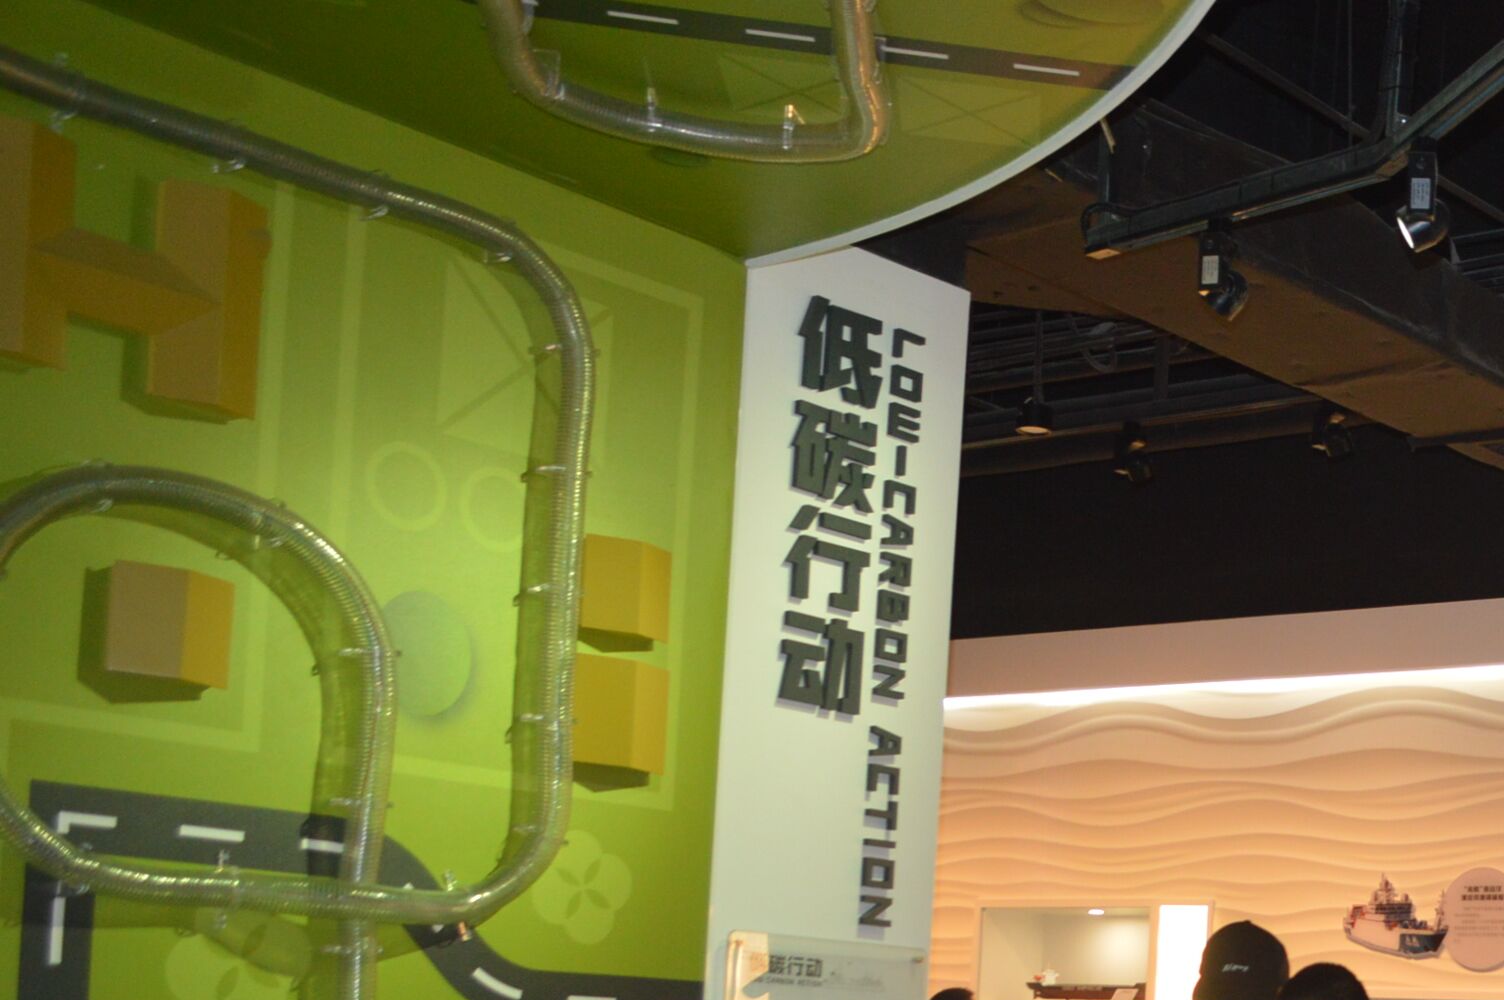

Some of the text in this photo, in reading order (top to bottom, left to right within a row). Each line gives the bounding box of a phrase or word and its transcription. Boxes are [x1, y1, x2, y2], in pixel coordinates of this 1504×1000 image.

[777, 295, 883, 716] 低碳行动
[859, 328, 926, 929] LOW-CARBON ACTION
[752, 953, 822, 977] 碳行动
